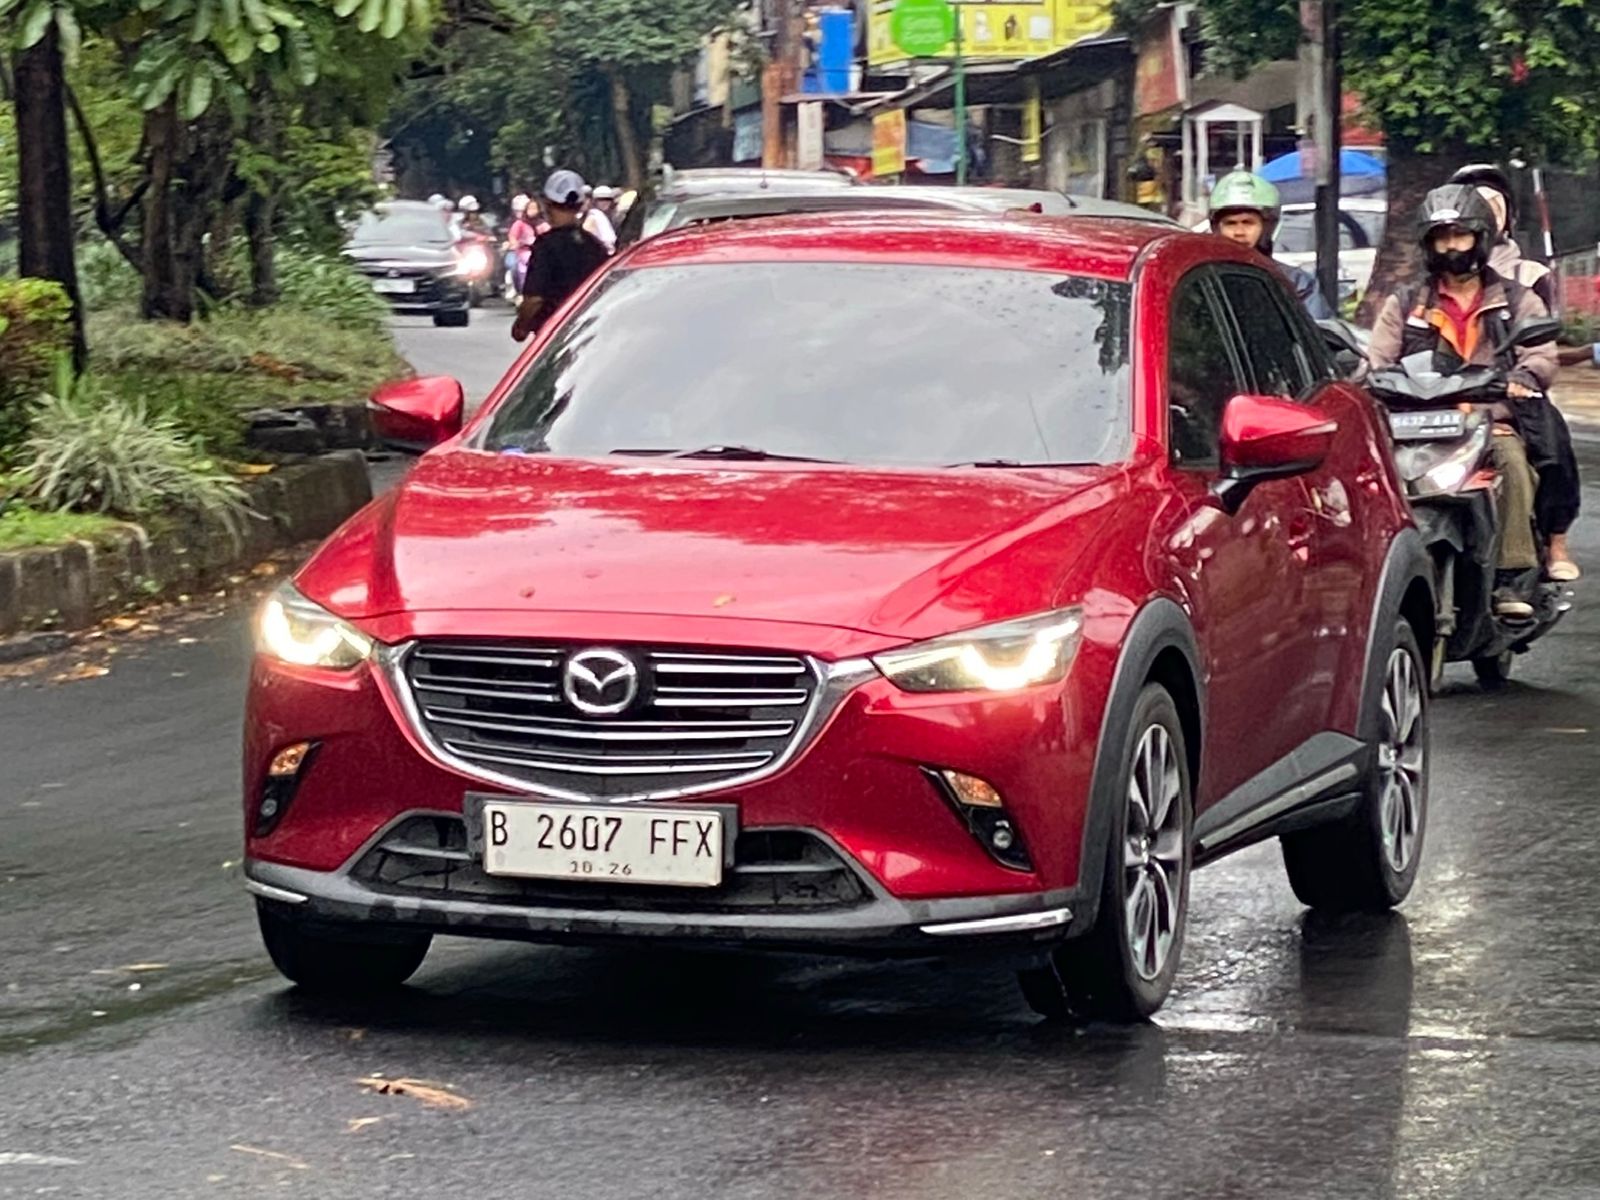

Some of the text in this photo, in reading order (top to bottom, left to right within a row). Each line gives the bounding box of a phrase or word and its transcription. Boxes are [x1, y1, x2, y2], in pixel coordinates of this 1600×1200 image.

[491, 810, 713, 857] B 2607 FFX
